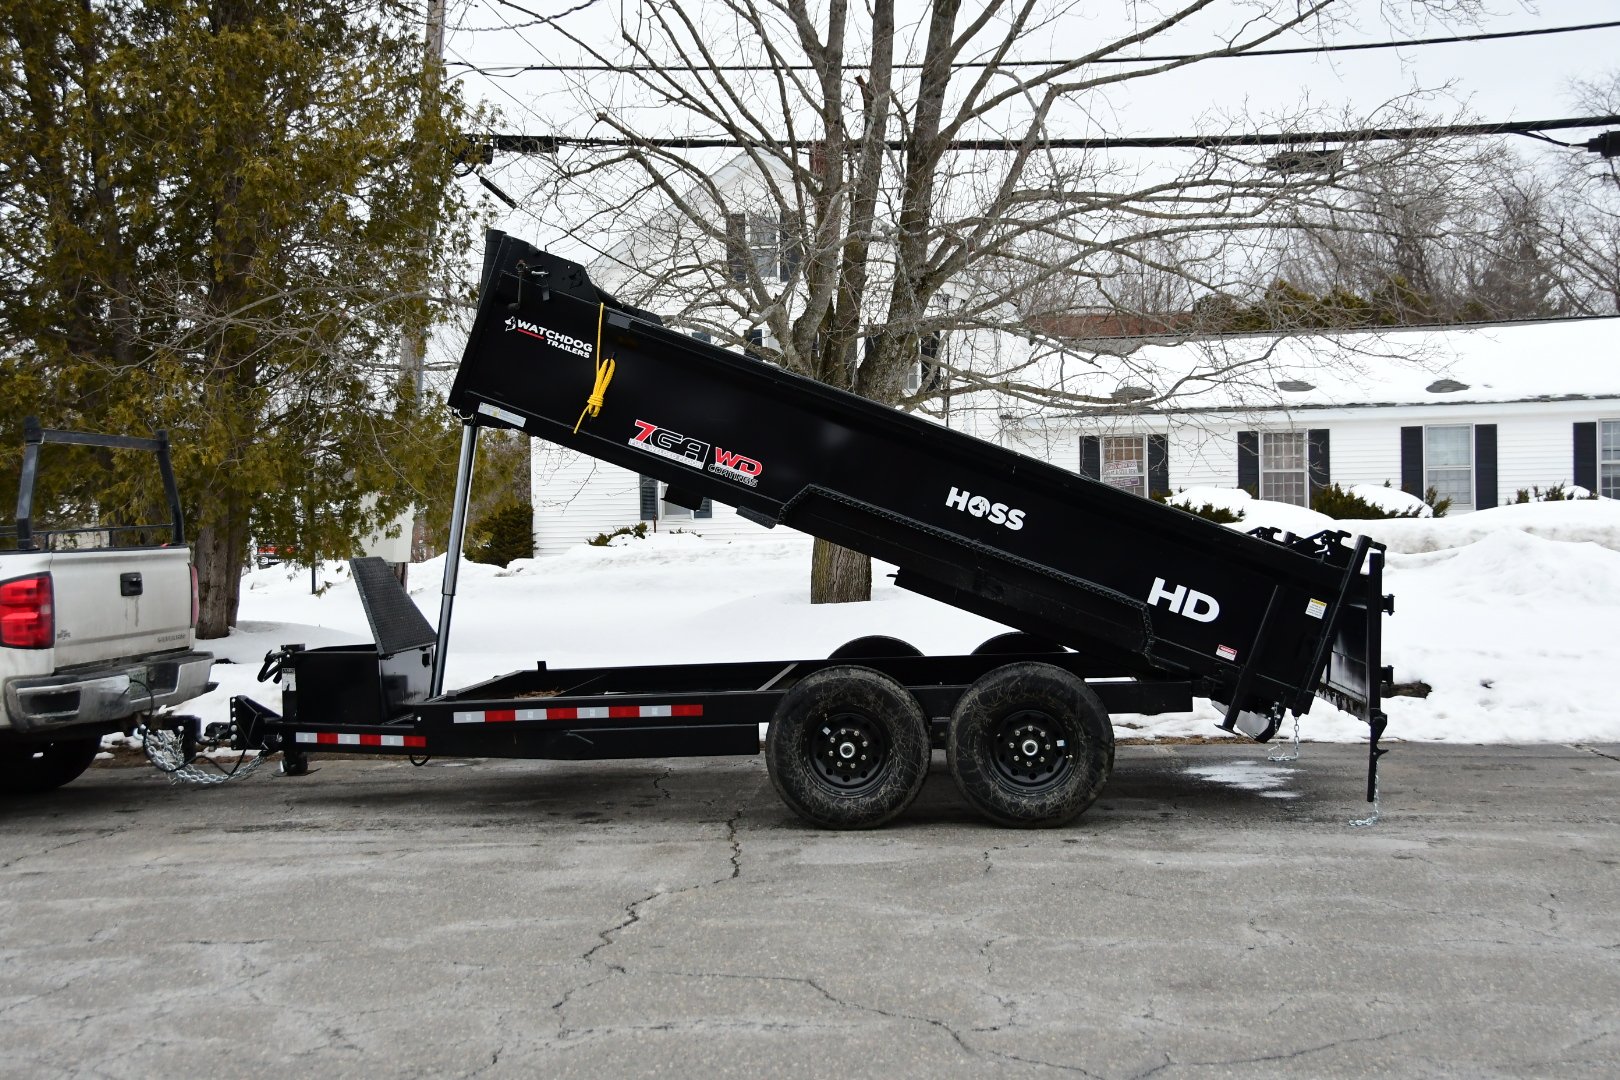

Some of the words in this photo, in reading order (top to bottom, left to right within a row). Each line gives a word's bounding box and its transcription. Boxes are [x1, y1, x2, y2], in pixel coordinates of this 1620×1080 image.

[517, 319, 593, 353] WATCHDOG
[546, 338, 590, 359] TRAILERS
[945, 486, 1026, 531] HOSS
[1147, 577, 1220, 623] HD
